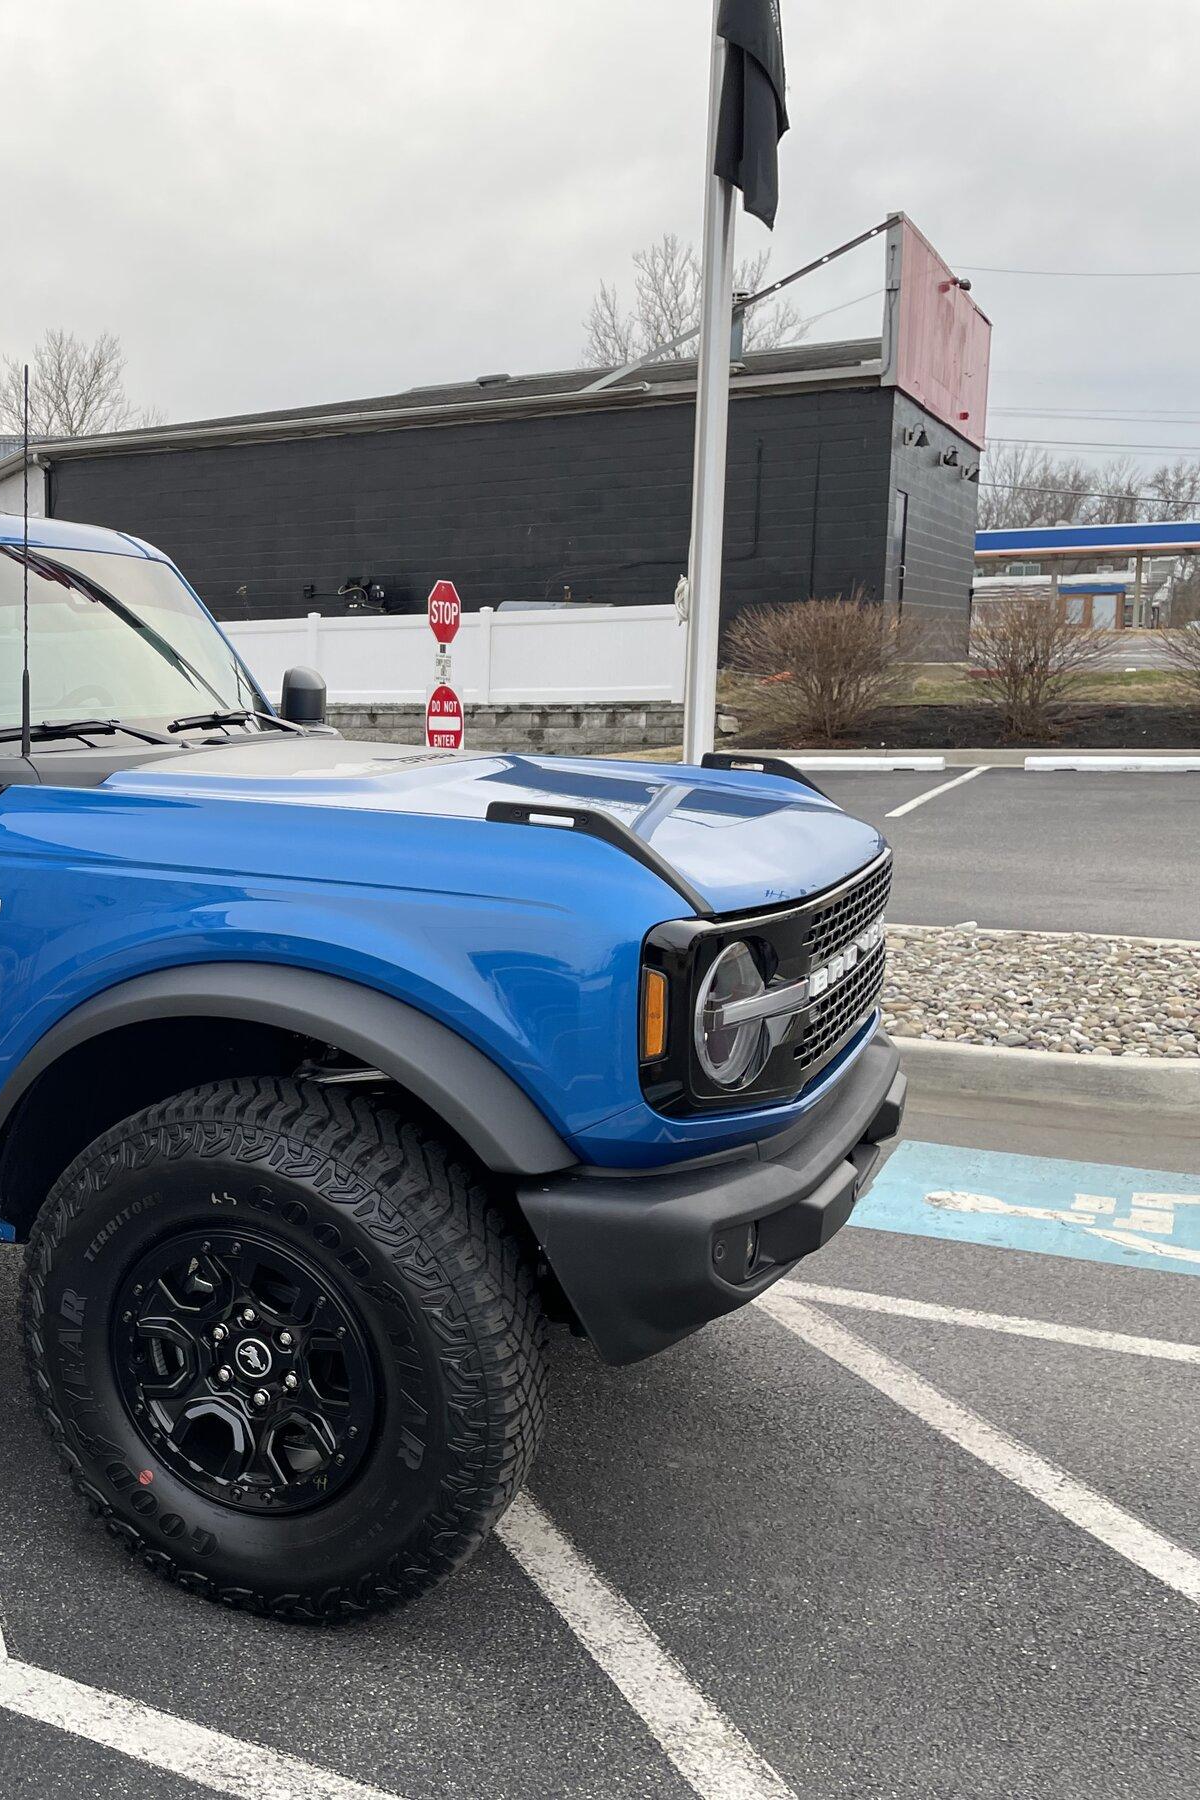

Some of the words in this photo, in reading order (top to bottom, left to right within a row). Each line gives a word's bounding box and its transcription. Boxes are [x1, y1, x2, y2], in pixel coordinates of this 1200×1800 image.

[431, 601, 459, 625] STOP
[432, 700, 441, 712] DO
[444, 701, 457, 713] NOT
[434, 735, 455, 747] ENTER
